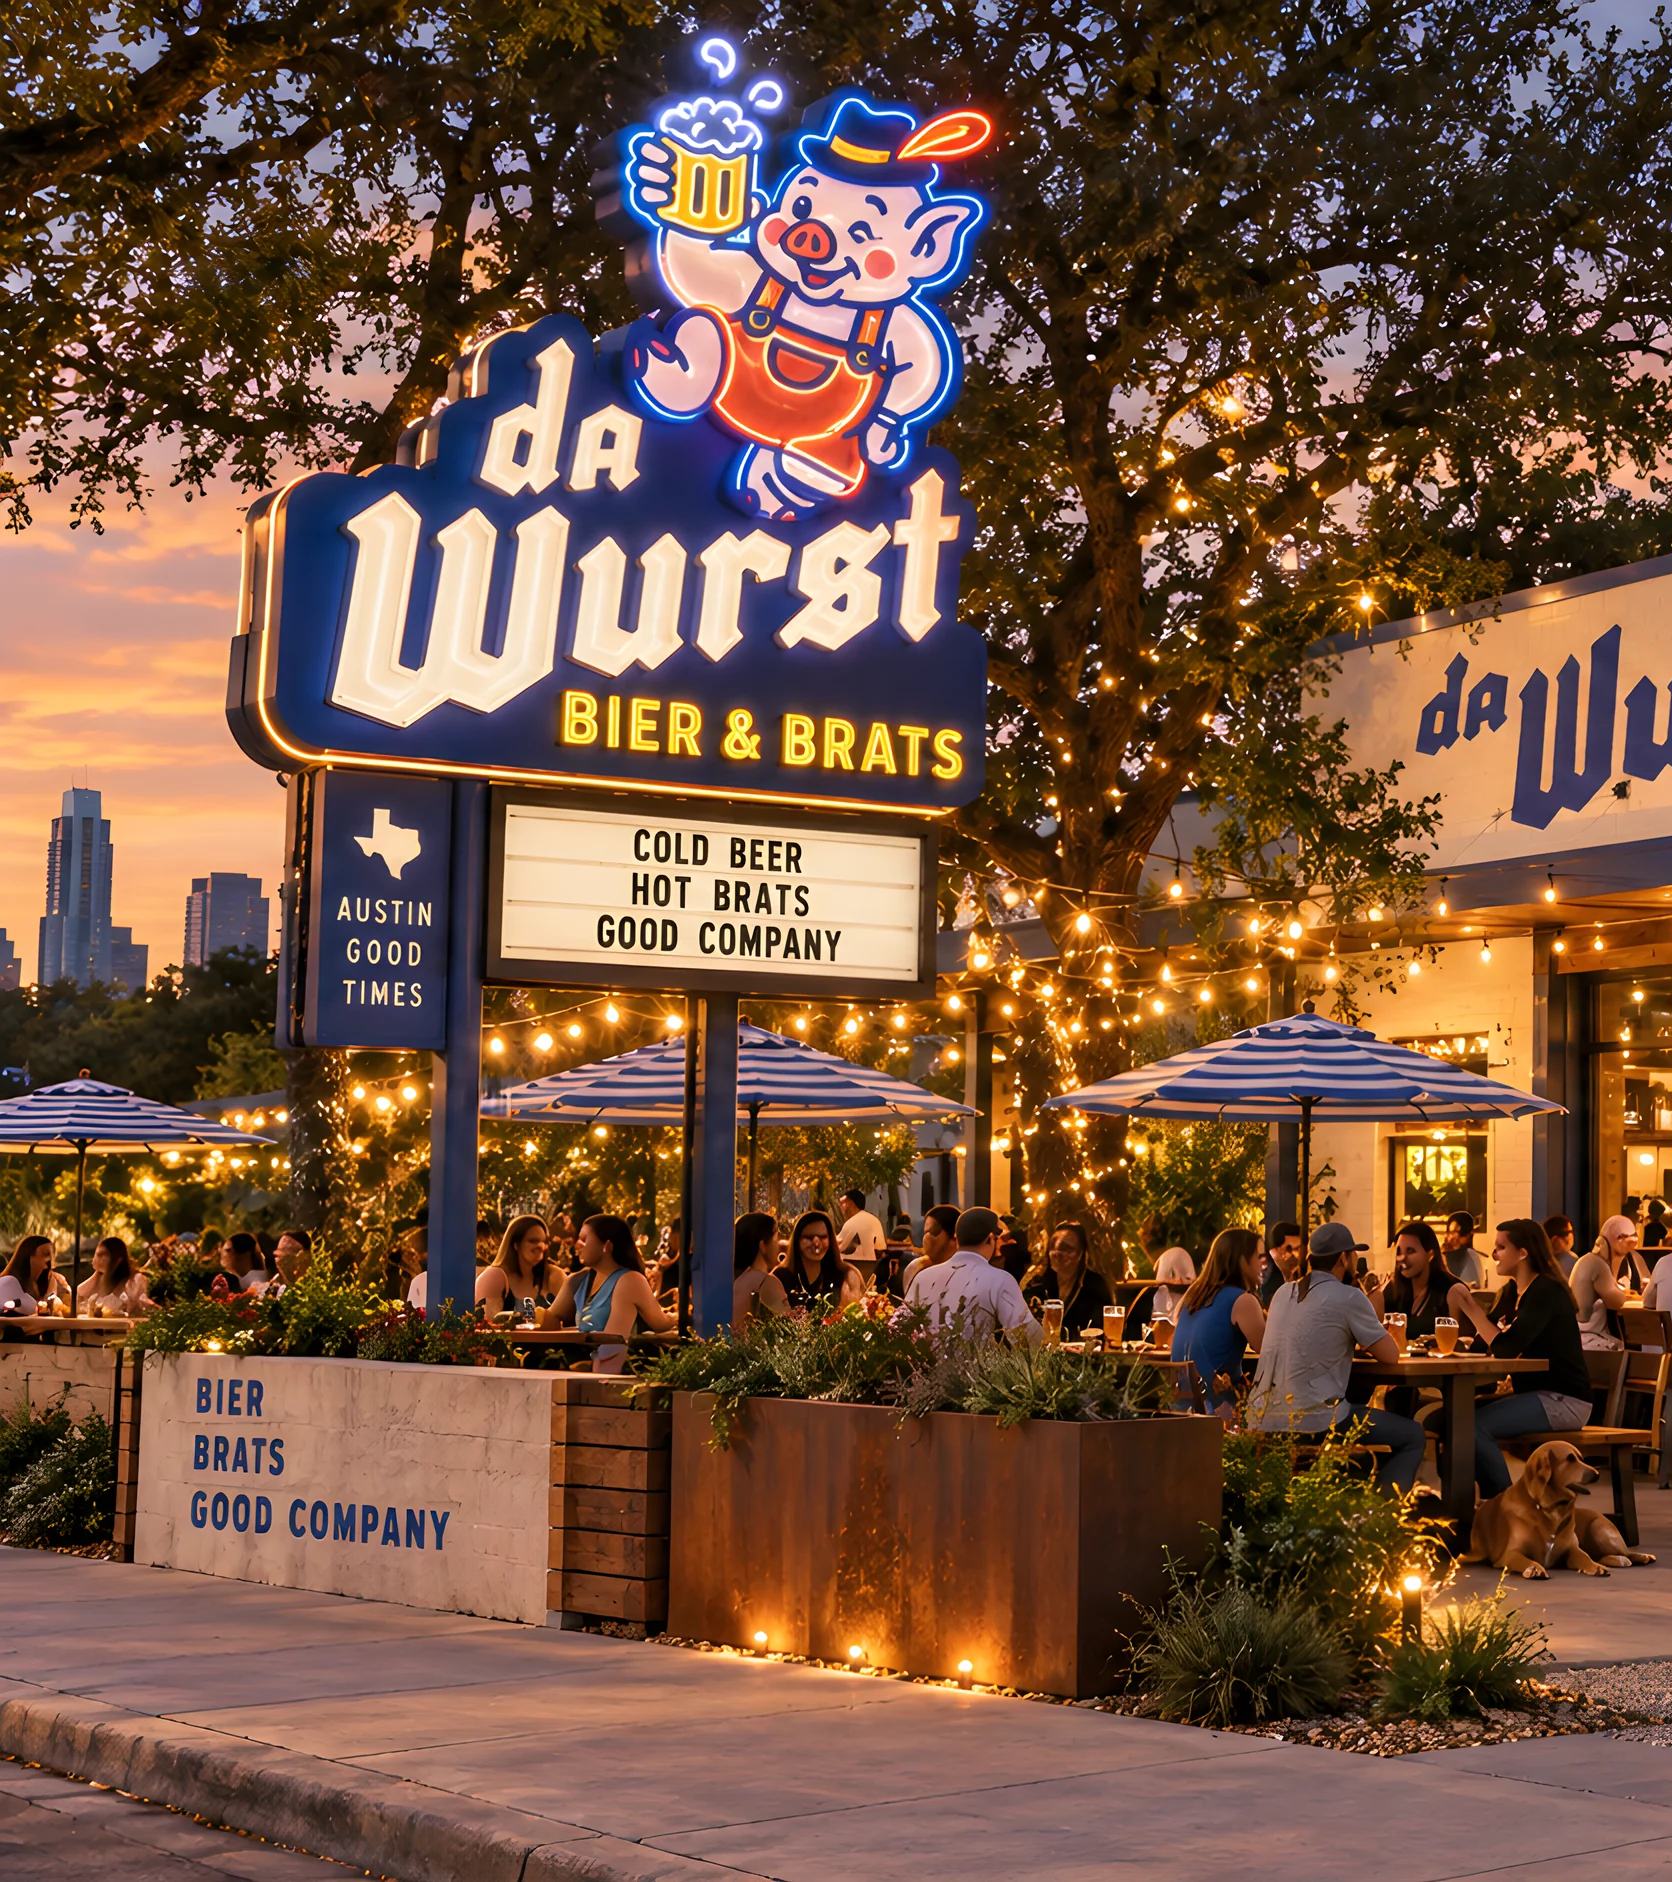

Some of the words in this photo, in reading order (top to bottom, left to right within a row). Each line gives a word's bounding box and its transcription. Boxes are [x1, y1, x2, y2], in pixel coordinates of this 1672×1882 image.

[327, 467, 961, 728] Wurst
[561, 690, 702, 757] BIER
[722, 708, 761, 760] &
[782, 712, 964, 780] BRATS
[633, 828, 709, 866] COLD
[730, 837, 803, 874] BEER
[337, 896, 432, 927] AUSTIN
[631, 872, 692, 909] HOT
[714, 879, 810, 917] BRATS
[346, 938, 422, 967] GOOD
[596, 914, 679, 952] GOOD
[699, 921, 842, 962] COMPANY
[342, 980, 422, 1007] TIMES
[196, 1377, 264, 1417] BIER
[193, 1434, 285, 1476] BRATS
[190, 1490, 272, 1535] GOOD
[288, 1498, 451, 1551] COMPANY
